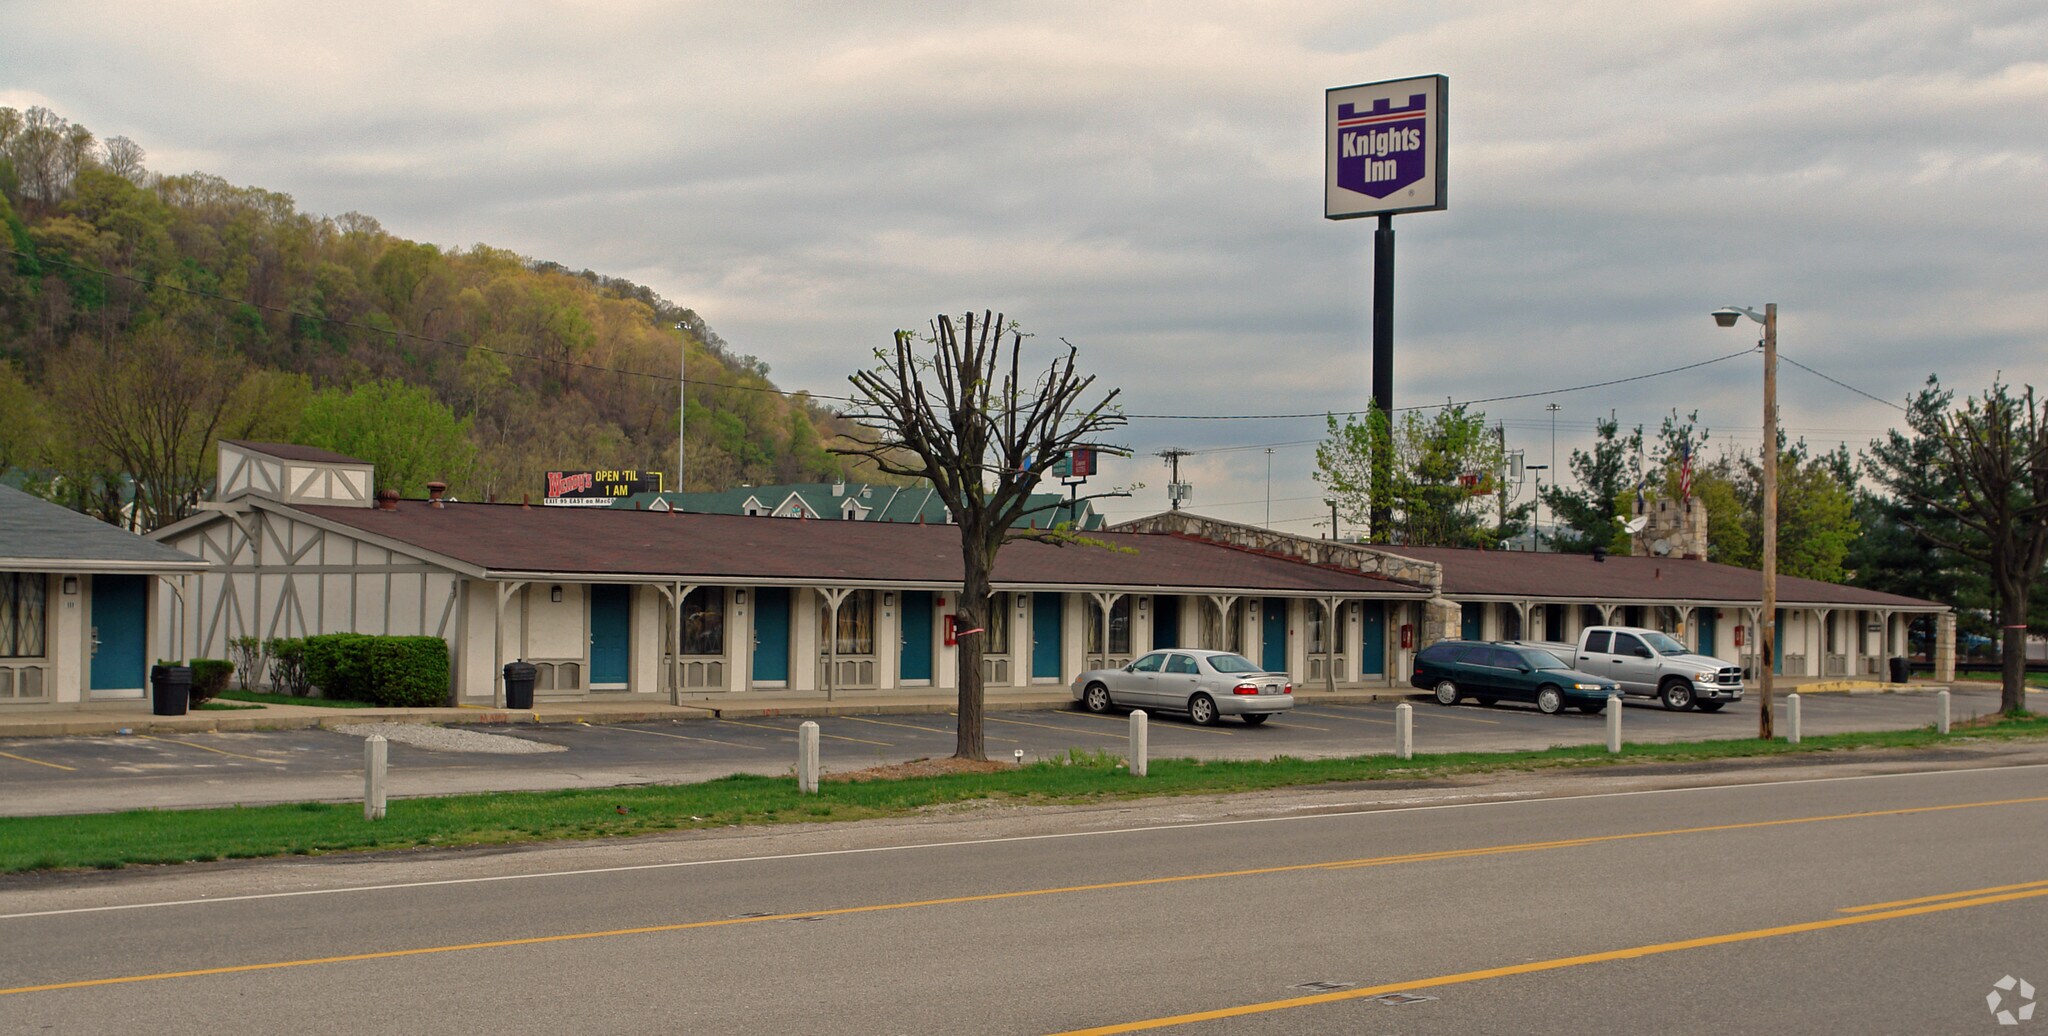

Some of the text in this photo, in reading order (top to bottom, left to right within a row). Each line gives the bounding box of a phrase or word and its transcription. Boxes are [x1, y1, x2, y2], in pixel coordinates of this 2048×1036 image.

[1342, 126, 1421, 158] Knights
[1364, 157, 1397, 183] Inn
[595, 470, 620, 482] OPEN
[605, 484, 628, 496] 1 AM
